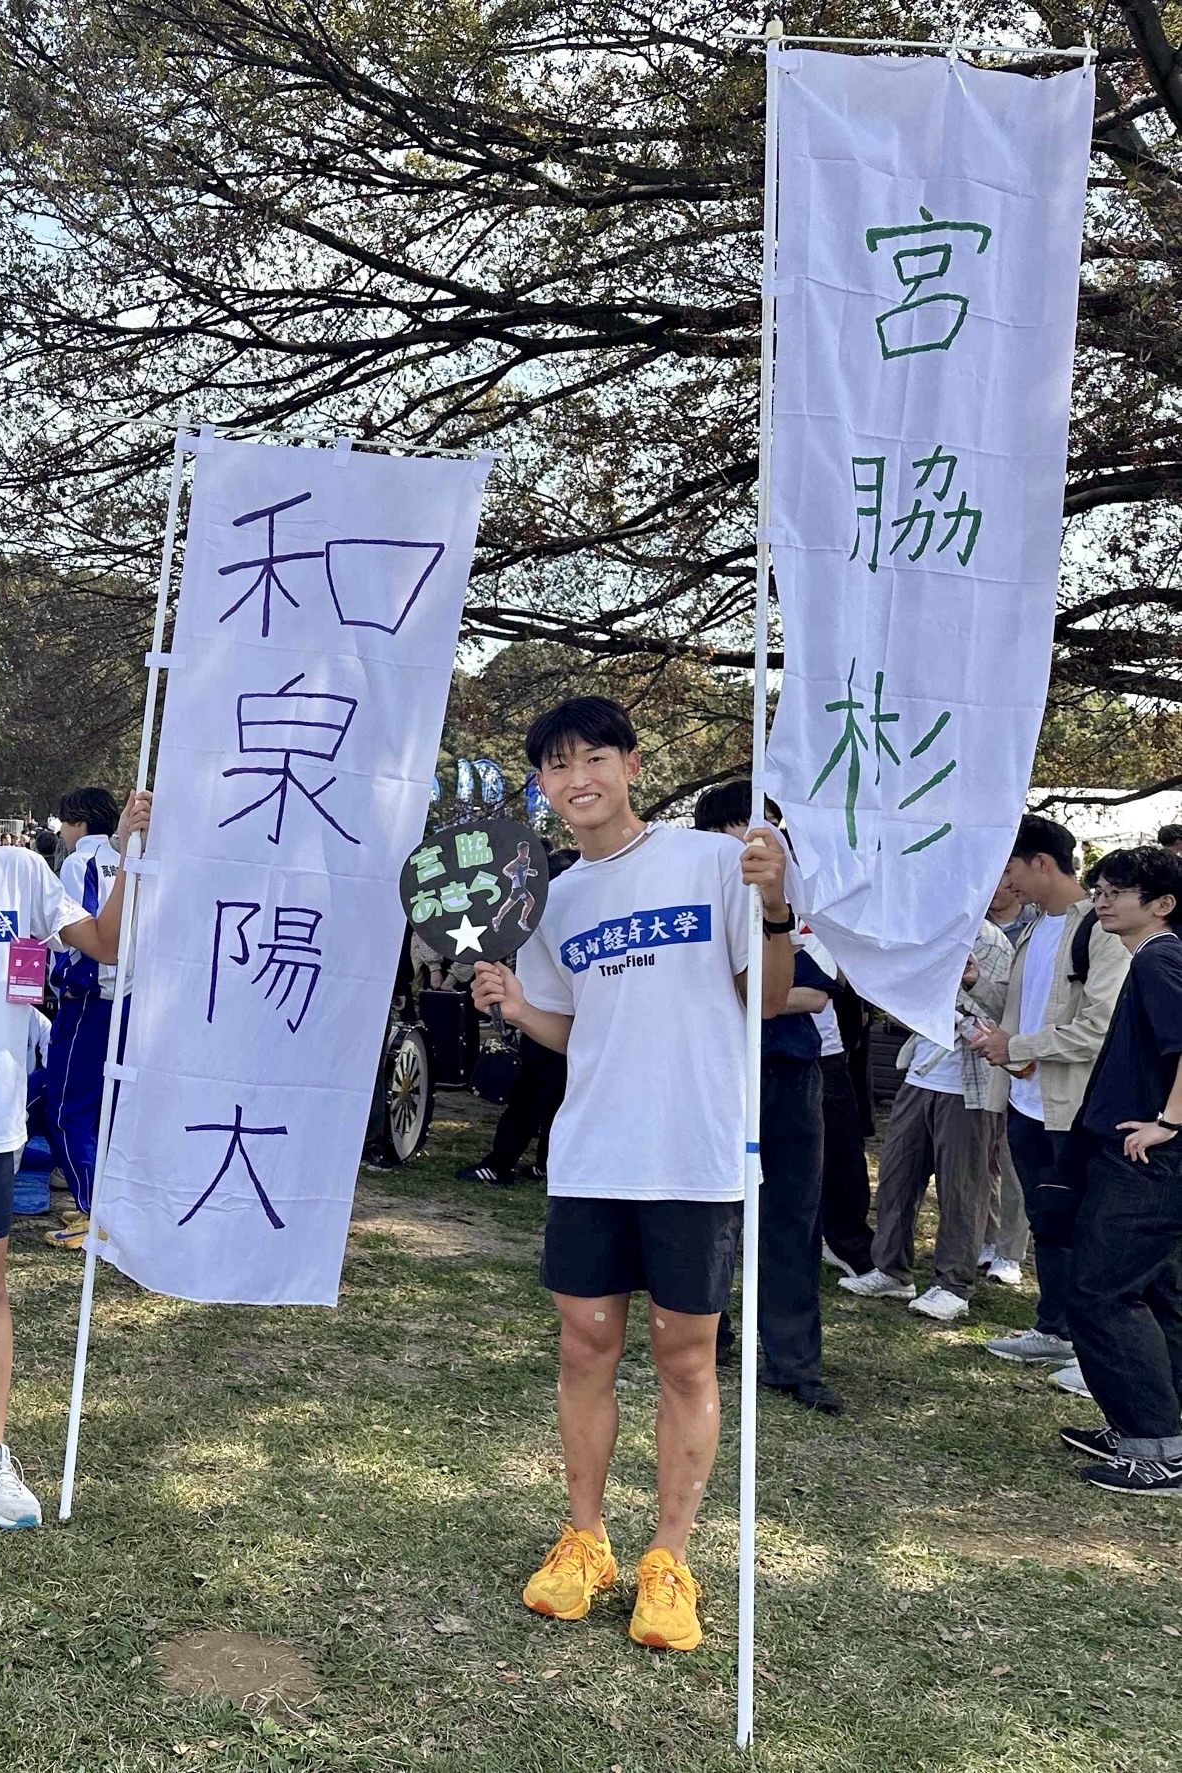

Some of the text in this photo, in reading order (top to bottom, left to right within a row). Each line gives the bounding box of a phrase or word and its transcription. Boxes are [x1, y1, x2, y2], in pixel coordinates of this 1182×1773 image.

[809, 206, 991, 855] 宮脇彬
[178, 492, 444, 1229] 和泉陽大
[410, 831, 493, 884] 宮脇
[410, 870, 502, 923] あきら
